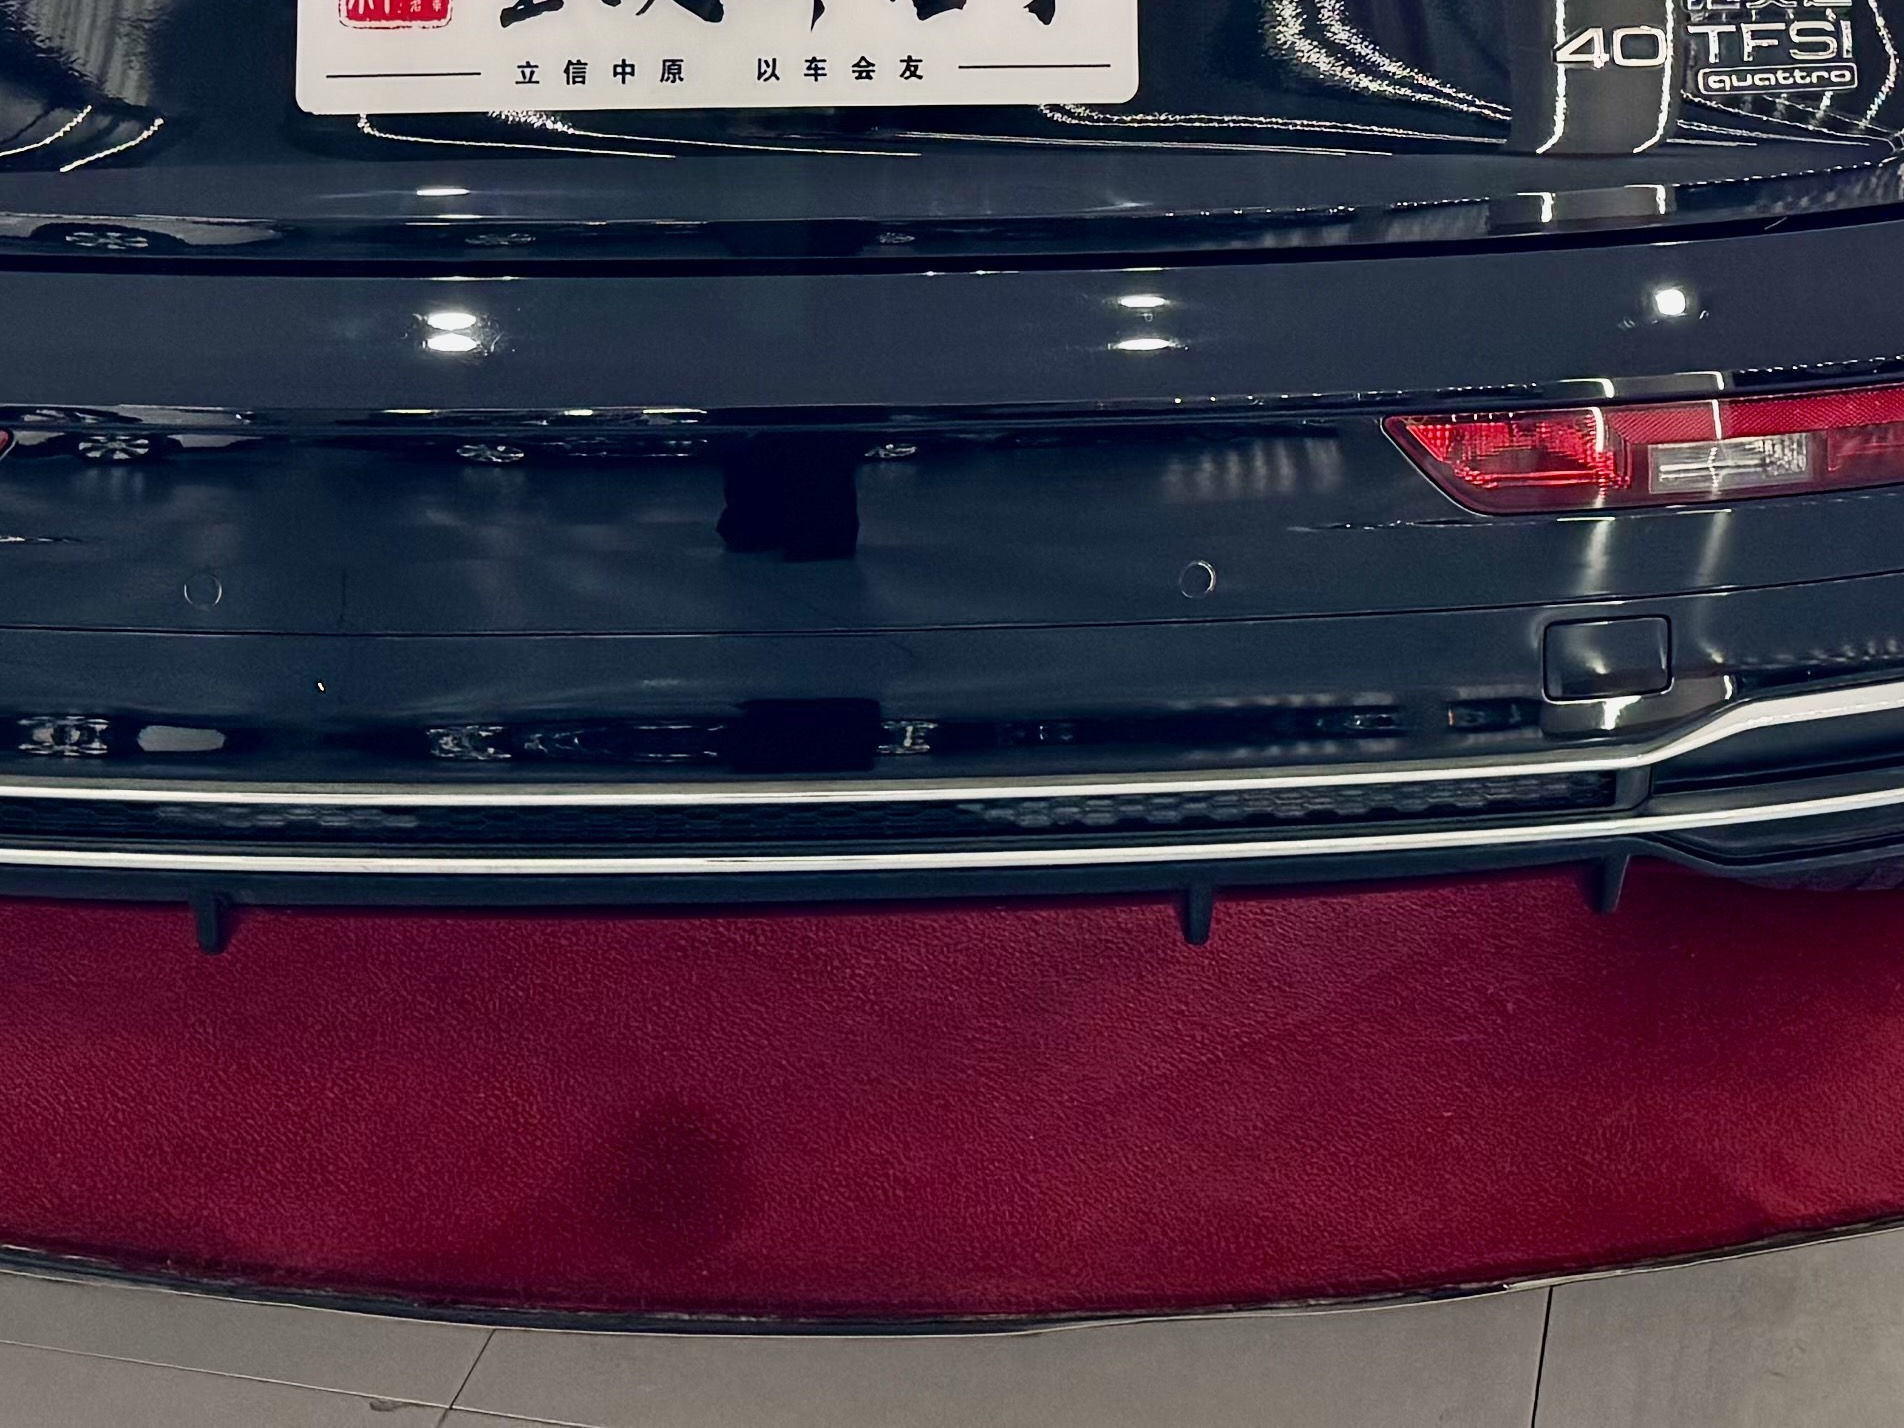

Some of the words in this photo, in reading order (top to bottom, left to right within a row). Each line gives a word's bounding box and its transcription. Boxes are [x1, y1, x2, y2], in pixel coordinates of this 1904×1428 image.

[1555, 26, 1668, 69] 40
[1687, 20, 1853, 64] TFSI
[514, 57, 685, 86] 立信中原
[756, 54, 925, 83] 以车会友
[1707, 69, 1852, 91] quattro
